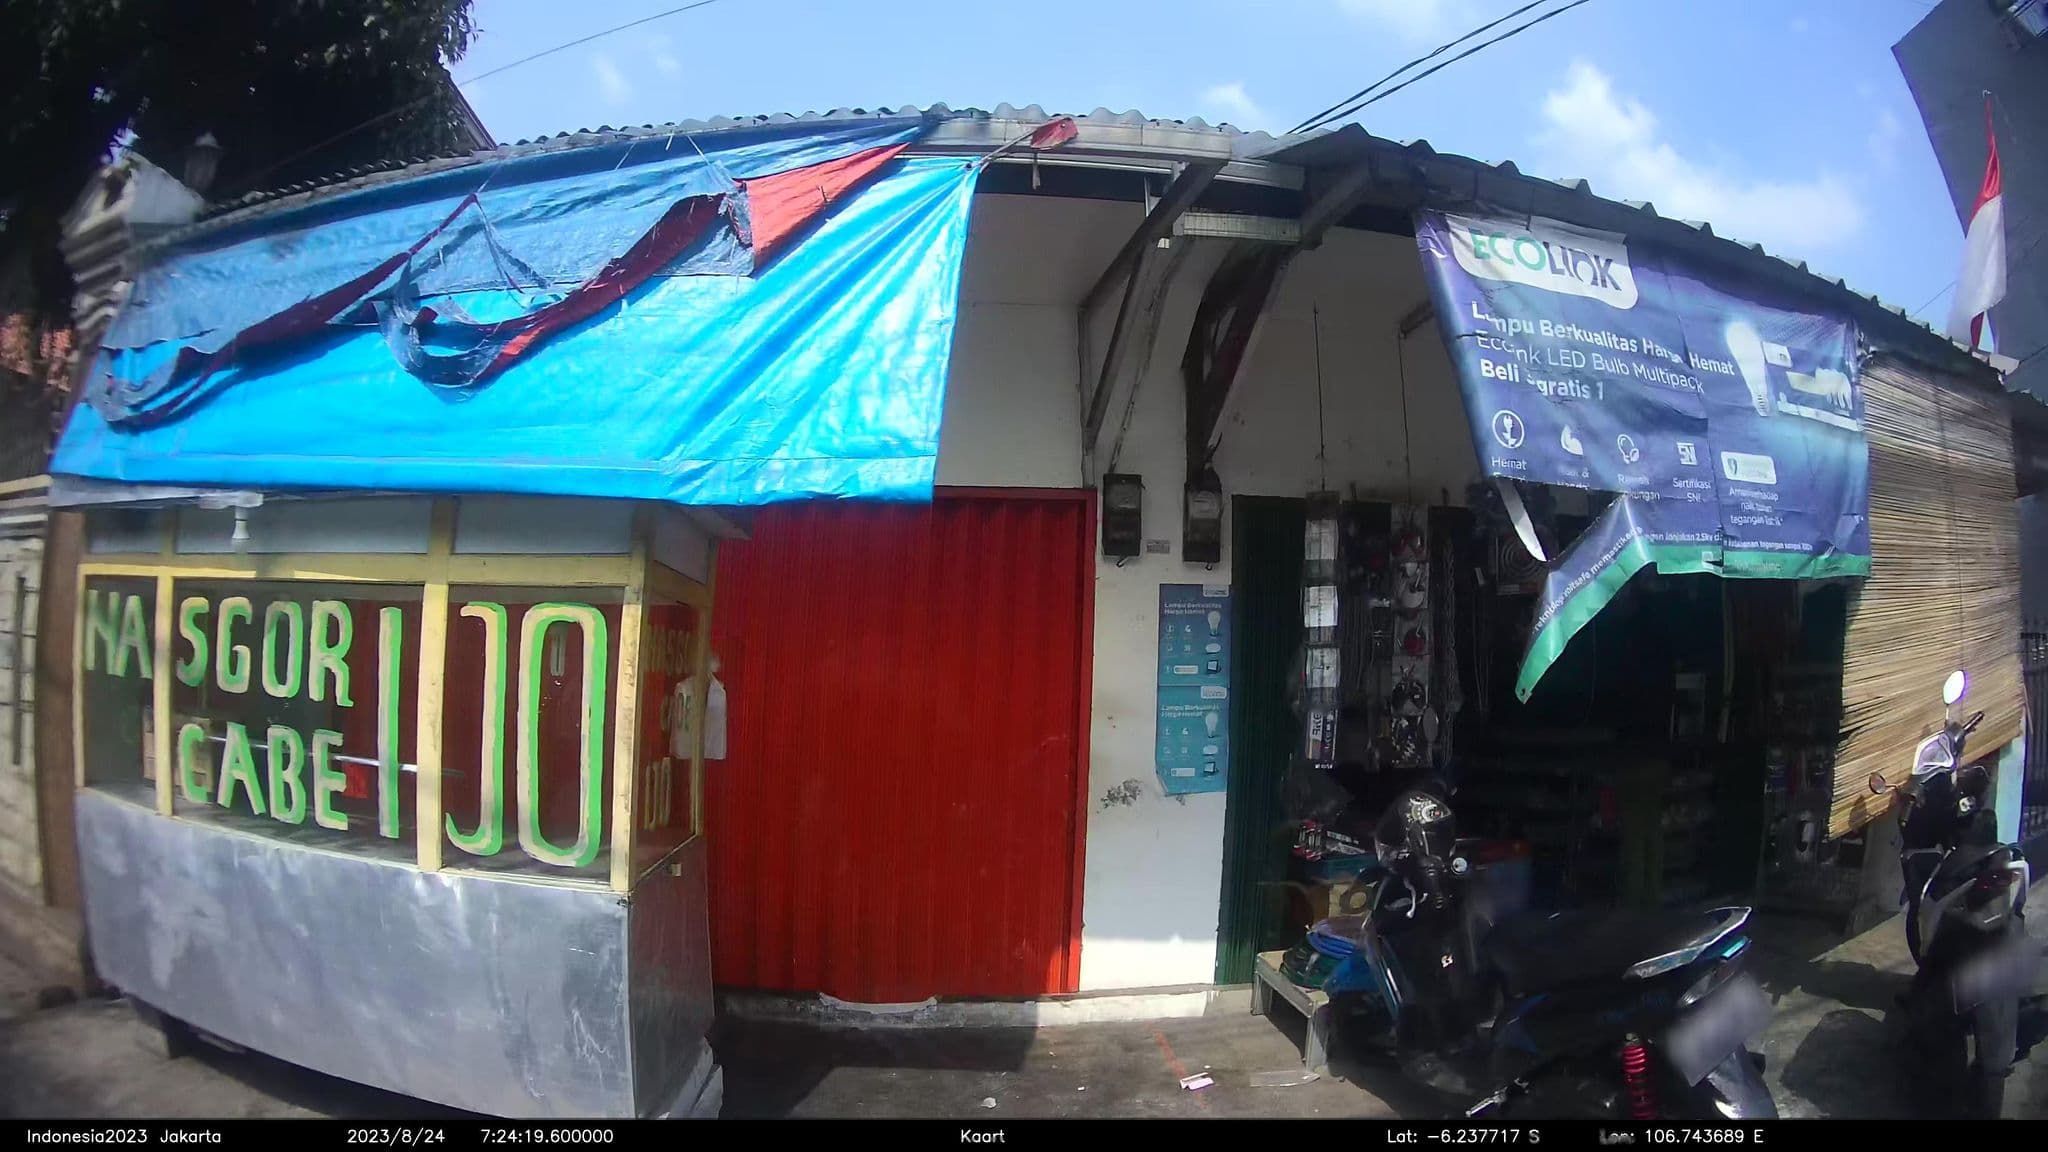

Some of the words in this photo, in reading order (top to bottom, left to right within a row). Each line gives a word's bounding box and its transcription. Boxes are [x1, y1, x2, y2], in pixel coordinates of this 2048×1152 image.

[1471, 300, 1535, 337] Lmpu
[1689, 351, 1736, 376] Hemat
[1480, 358, 1520, 384] Beli
[1536, 379, 1592, 400] gratis
[1547, 347, 1586, 369] LED
[1592, 353, 1630, 377] Bulb
[1632, 363, 1705, 394] Multipack
[1491, 456, 1528, 471] Hemat
[177, 720, 349, 831] CABE
